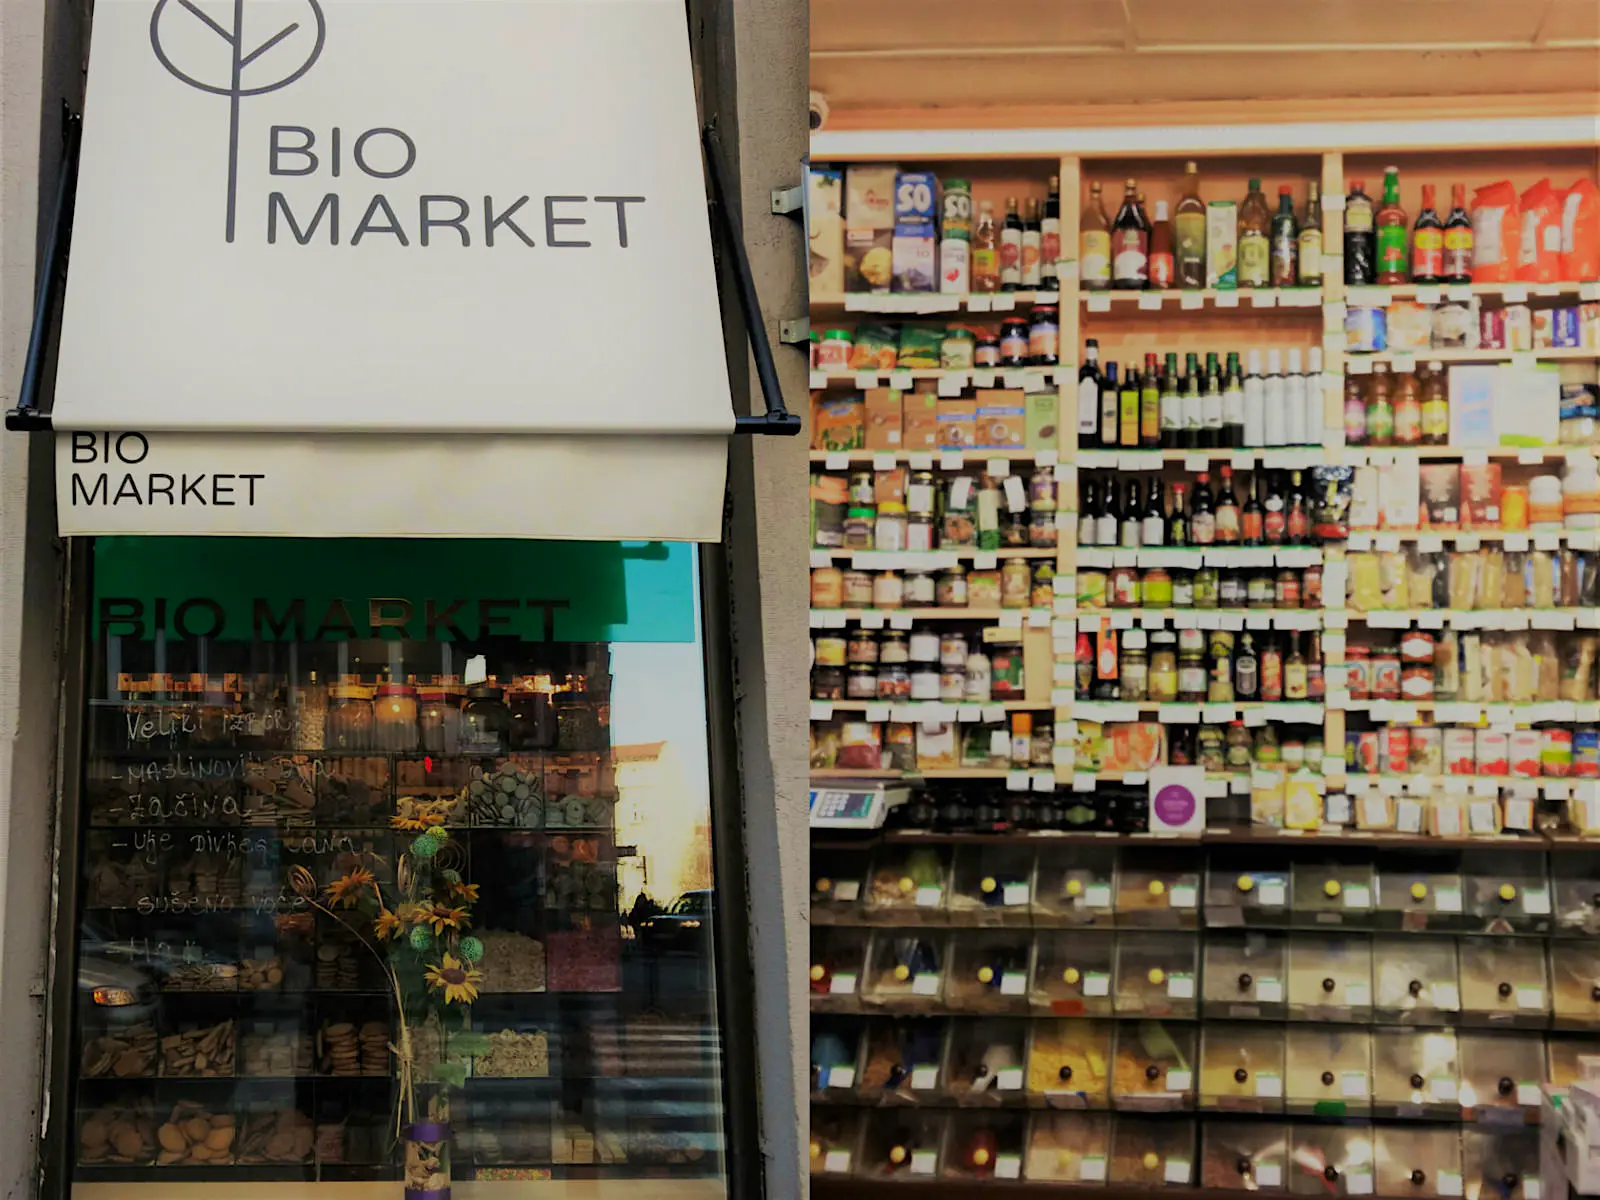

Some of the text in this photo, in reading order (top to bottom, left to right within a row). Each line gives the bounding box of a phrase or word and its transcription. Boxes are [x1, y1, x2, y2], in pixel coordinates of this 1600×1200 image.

[268, 126, 417, 178] BIO
[267, 192, 647, 249] MARKET
[71, 431, 150, 464] BIO
[71, 473, 265, 507] MARKET
[99, 596, 571, 643] BIO MARKET
